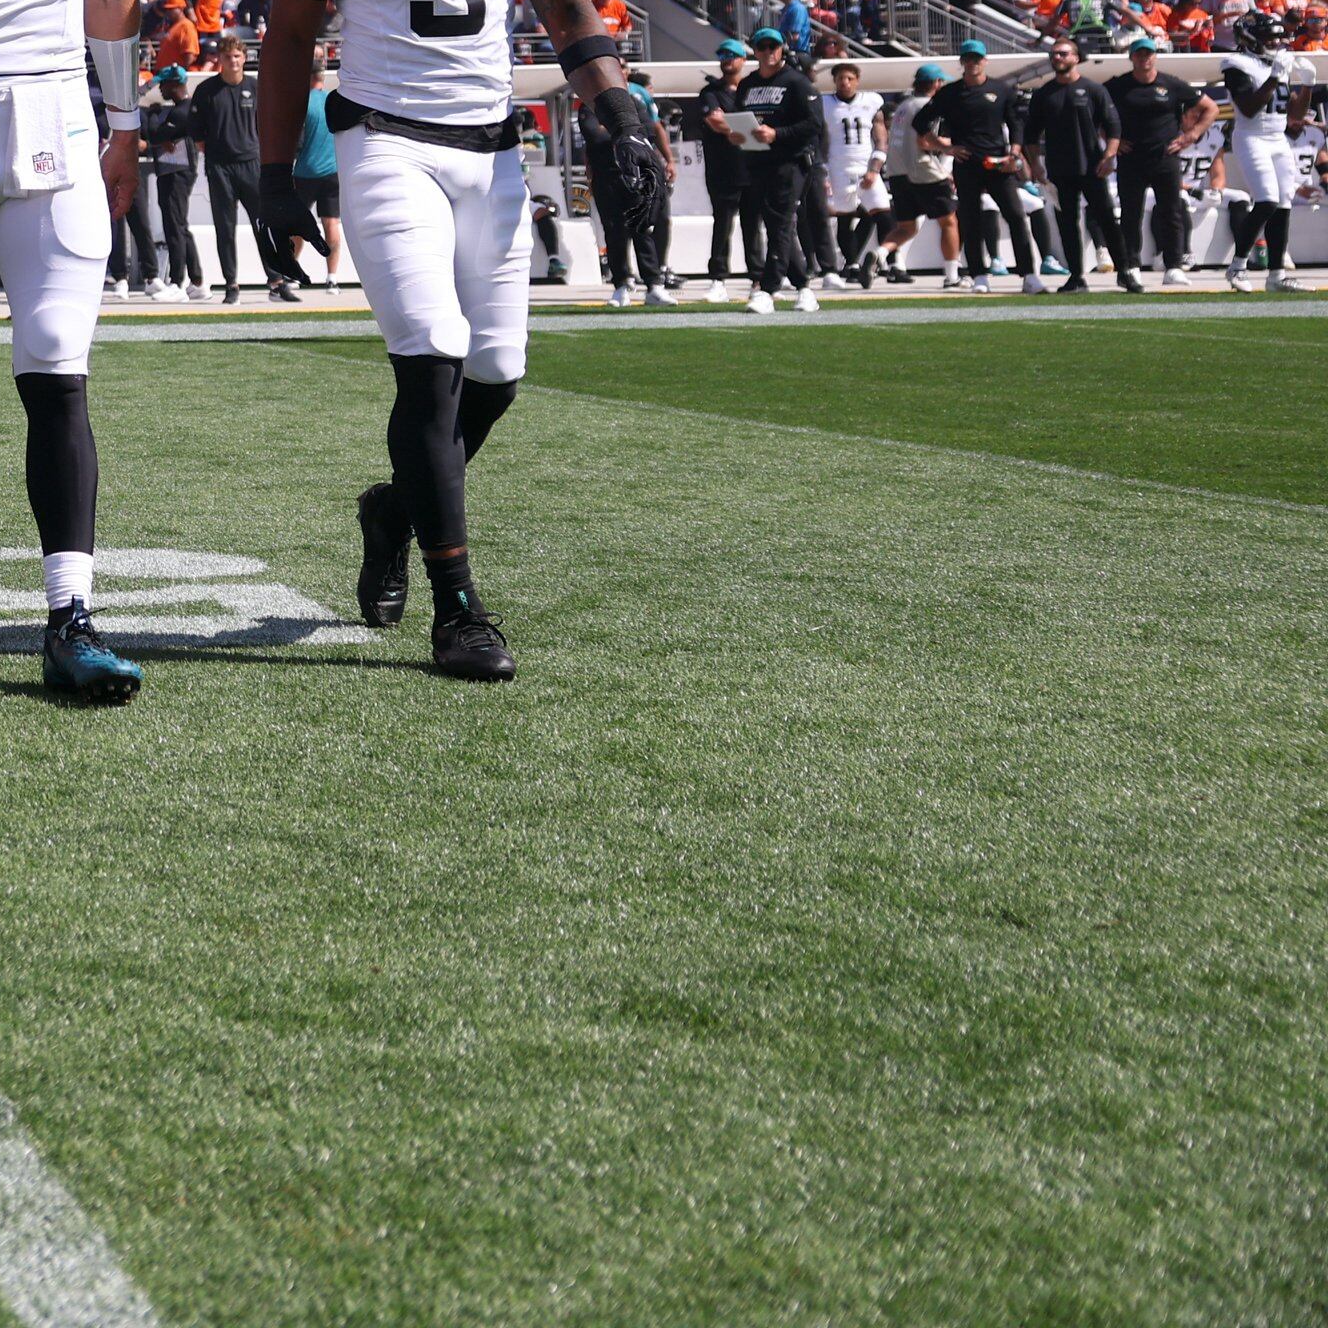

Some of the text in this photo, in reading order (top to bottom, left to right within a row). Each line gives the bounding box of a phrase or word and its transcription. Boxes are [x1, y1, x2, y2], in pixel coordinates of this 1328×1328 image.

[744, 85, 788, 107] JAGUARS
[841, 117, 864, 146] 11
[35, 159, 53, 172] NFL
